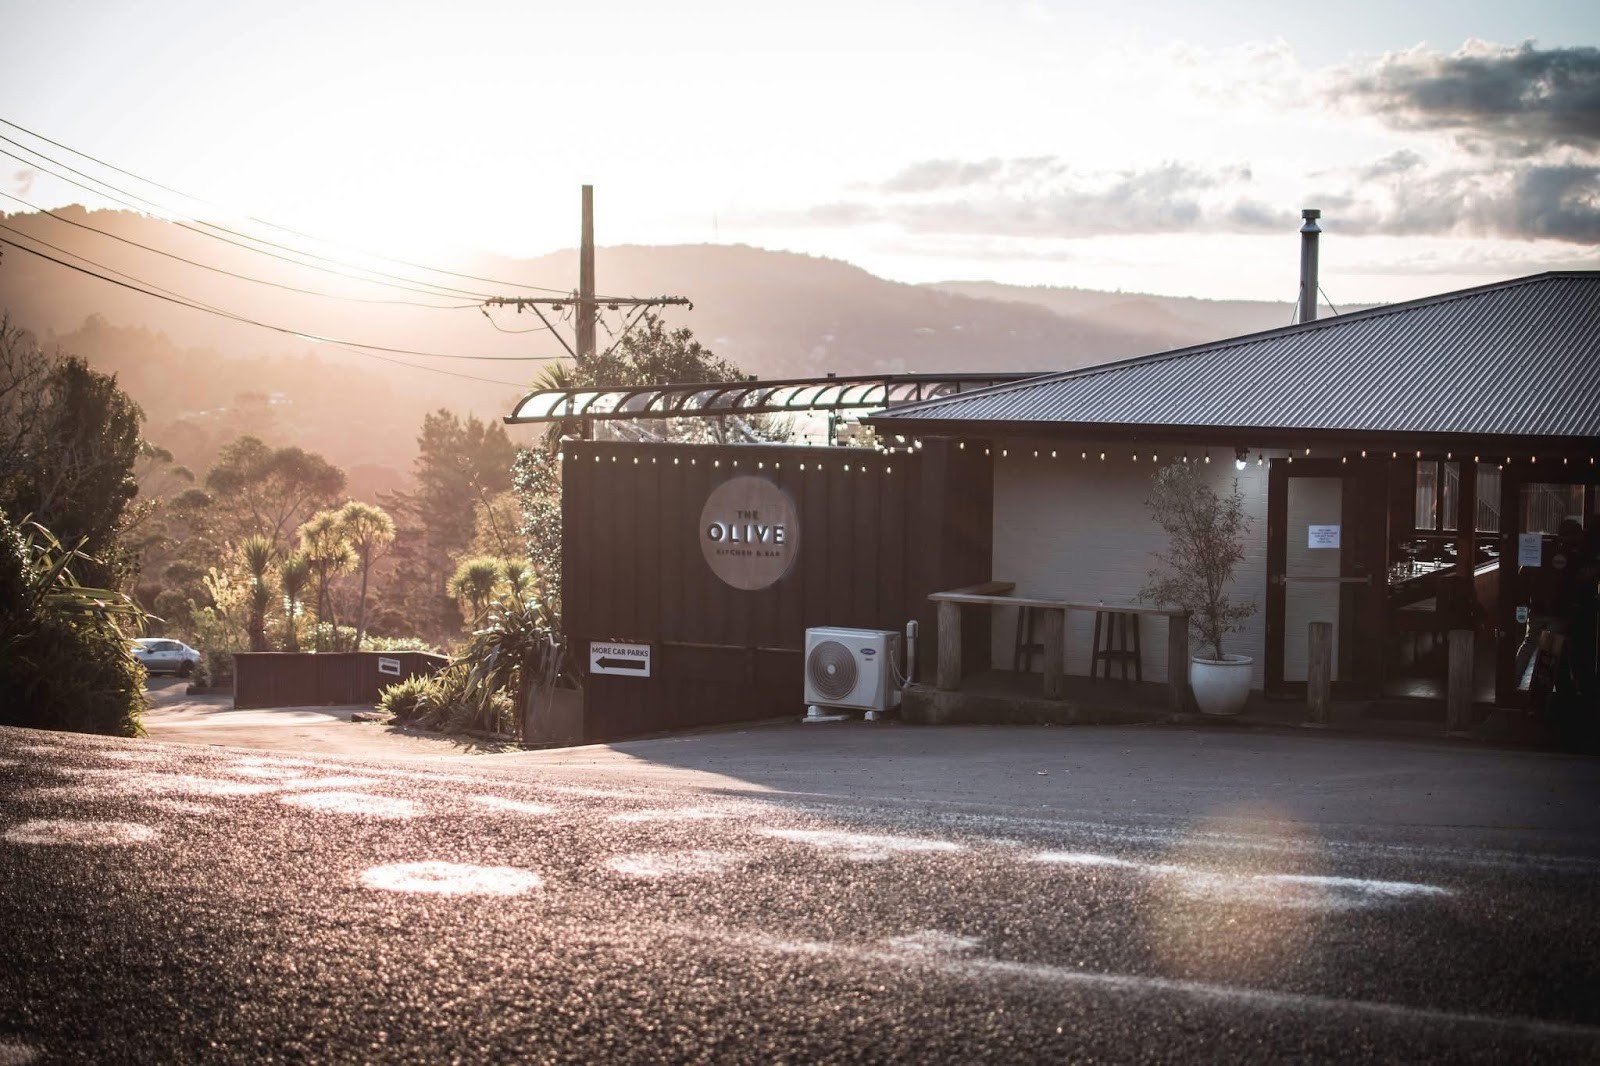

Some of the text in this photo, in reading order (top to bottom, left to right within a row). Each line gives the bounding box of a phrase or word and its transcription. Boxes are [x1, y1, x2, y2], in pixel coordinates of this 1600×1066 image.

[737, 510, 759, 519] THE
[707, 522, 785, 545] OLIVE
[716, 549, 753, 557] KITCHEN
[592, 647, 649, 657] MORE CAR PARKS
